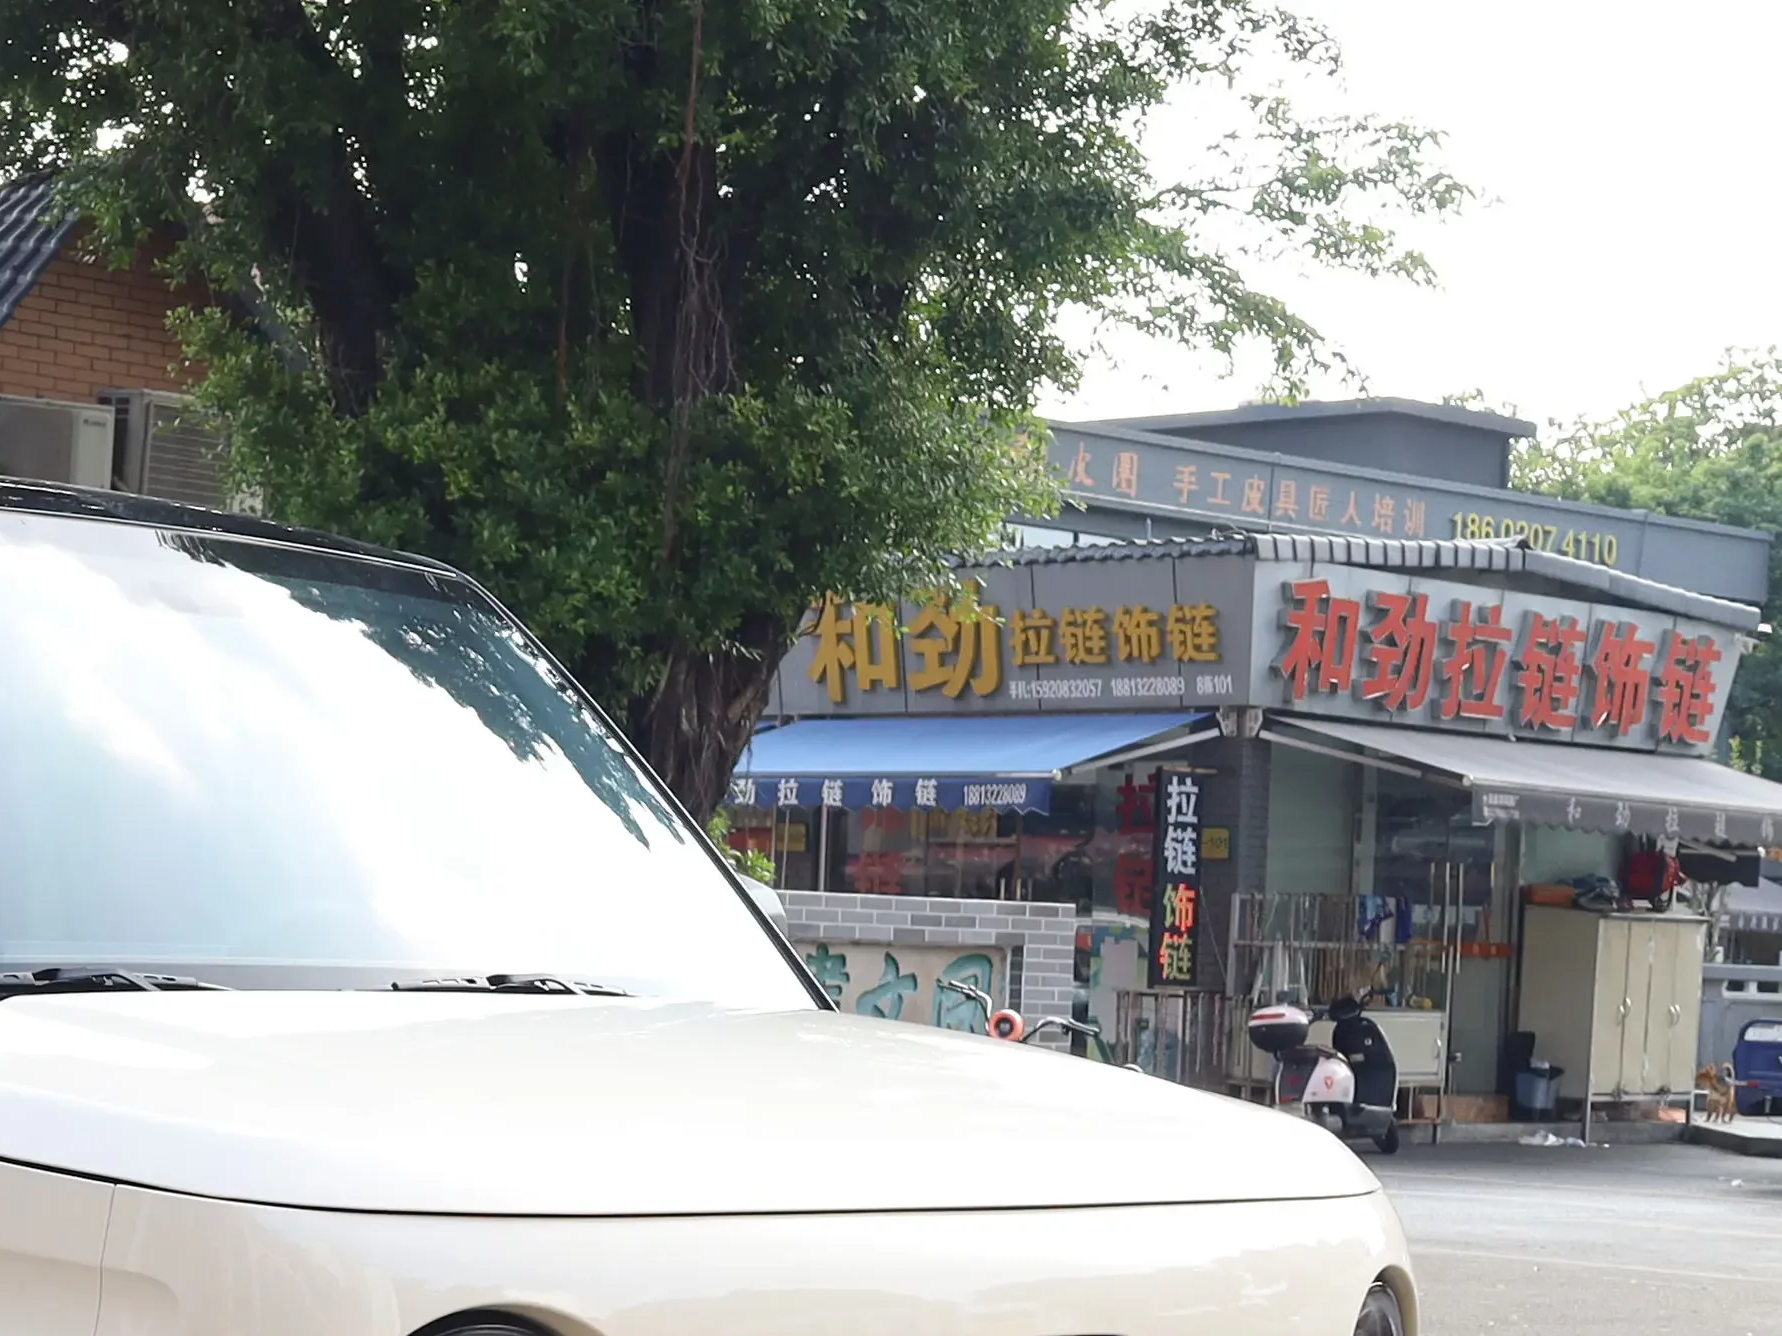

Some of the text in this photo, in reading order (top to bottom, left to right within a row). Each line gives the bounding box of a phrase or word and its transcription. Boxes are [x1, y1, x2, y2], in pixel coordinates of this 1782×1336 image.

[1173, 465, 1425, 538] 手工皮具匠人培训
[1281, 578, 1722, 744] 和劲拉链饰链
[1160, 776, 1199, 981] 拉链饰链
